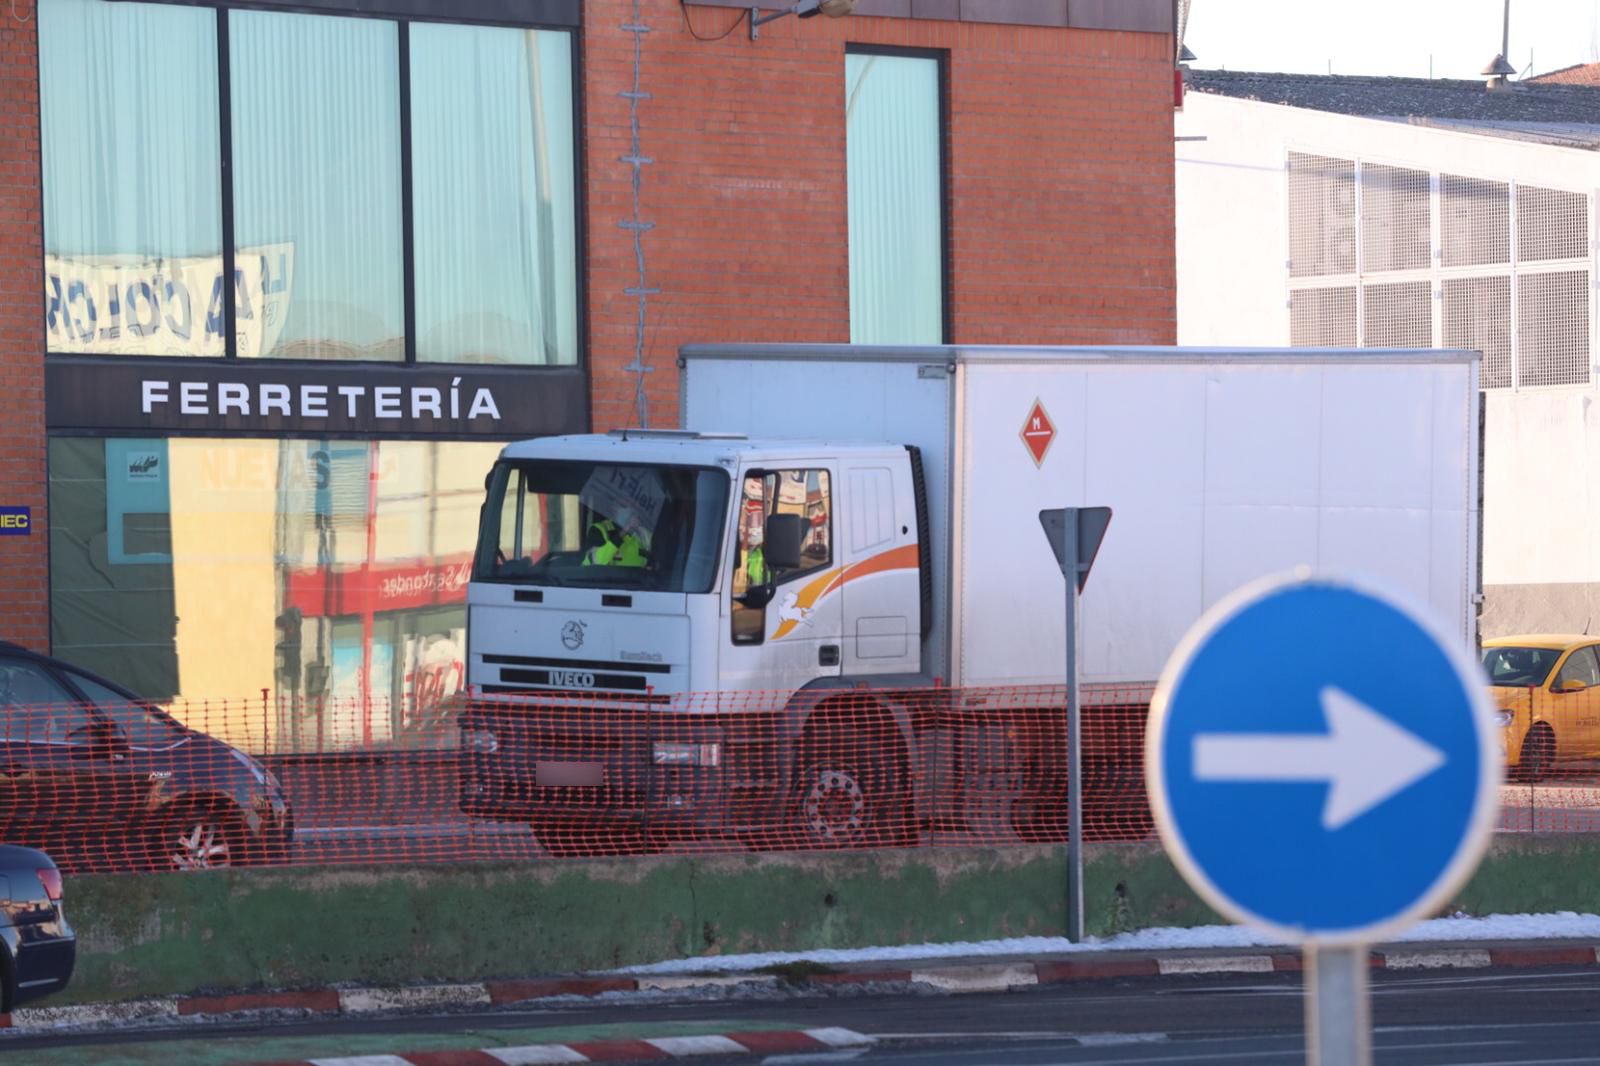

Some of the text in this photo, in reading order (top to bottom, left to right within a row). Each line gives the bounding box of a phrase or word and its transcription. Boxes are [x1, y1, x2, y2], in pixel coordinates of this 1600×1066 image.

[141, 376, 502, 420] FERRETERÍA
[1032, 416, 1041, 431] M
[548, 671, 595, 687] IVECO
